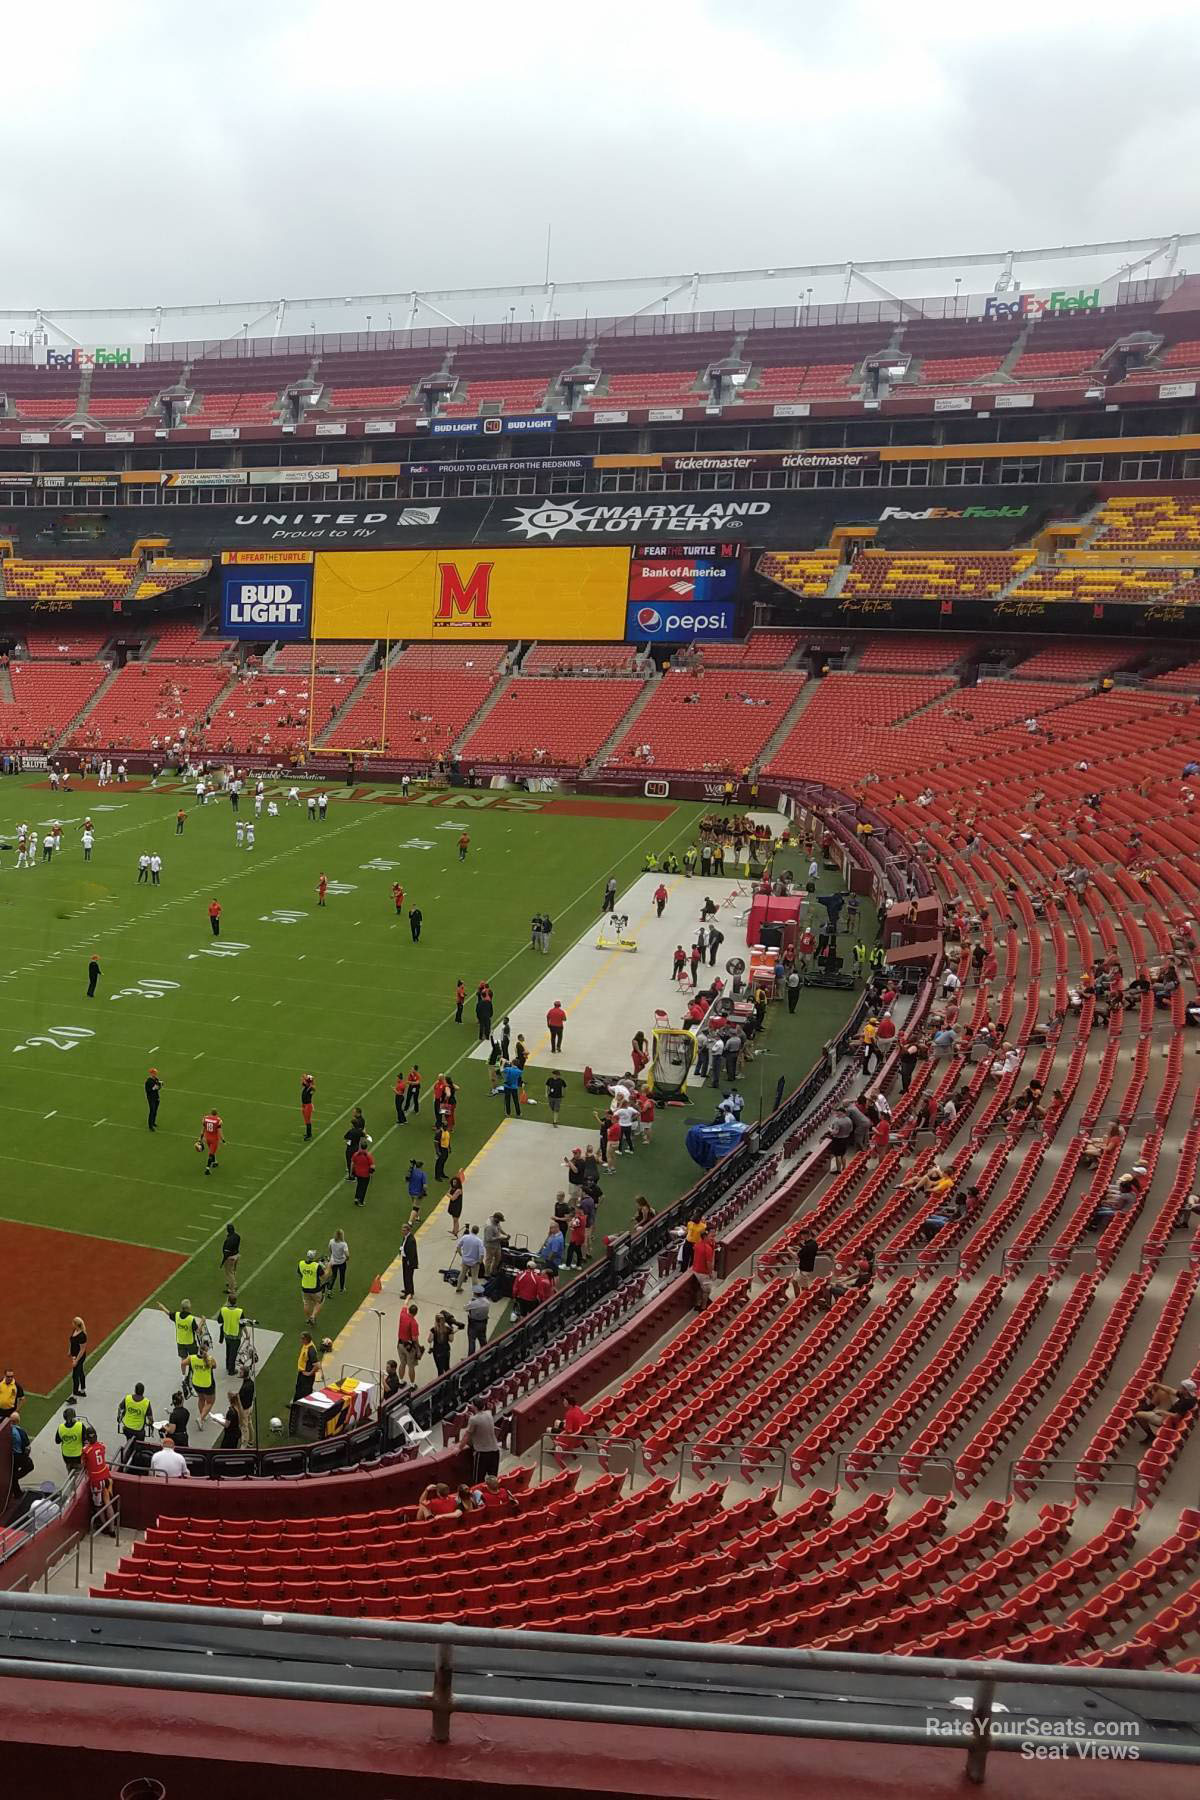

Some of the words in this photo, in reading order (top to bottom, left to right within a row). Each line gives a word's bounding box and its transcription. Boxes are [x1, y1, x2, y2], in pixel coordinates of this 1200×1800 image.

[984, 289, 1101, 317] FedExField
[46, 348, 132, 365] FedExField
[434, 424, 452, 433] BUD
[452, 422, 478, 432] LIGHT
[507, 421, 526, 430] BUD
[526, 419, 552, 429] LIGHT
[438, 464, 463, 473] PROUD
[463, 464, 476, 472] TO
[476, 463, 508, 472] DELIVER
[509, 462, 525, 470] FOR
[525, 461, 541, 469] THE
[541, 459, 583, 469] REDSKINS.
[592, 502, 772, 519] MARYLAND
[878, 505, 1029, 521] FedExField
[234, 513, 388, 525] UNITED
[271, 528, 325, 539] Proud
[329, 528, 348, 538] to
[351, 527, 377, 538] fly
[642, 567, 669, 578] Bank
[669, 567, 683, 578] of
[682, 566, 727, 577] America
[239, 585, 293, 605] BUD
[433, 561, 496, 620] M
[229, 604, 302, 624] LIGHT
[665, 607, 726, 633] pepsi
[22, 760, 48, 769] SALUTE
[247, 768, 280, 780] haritable
[649, 784, 665, 796] 40
[119, 979, 182, 999] 30
[25, 1025, 97, 1051] 20
[94, 1449, 103, 1466] 6
